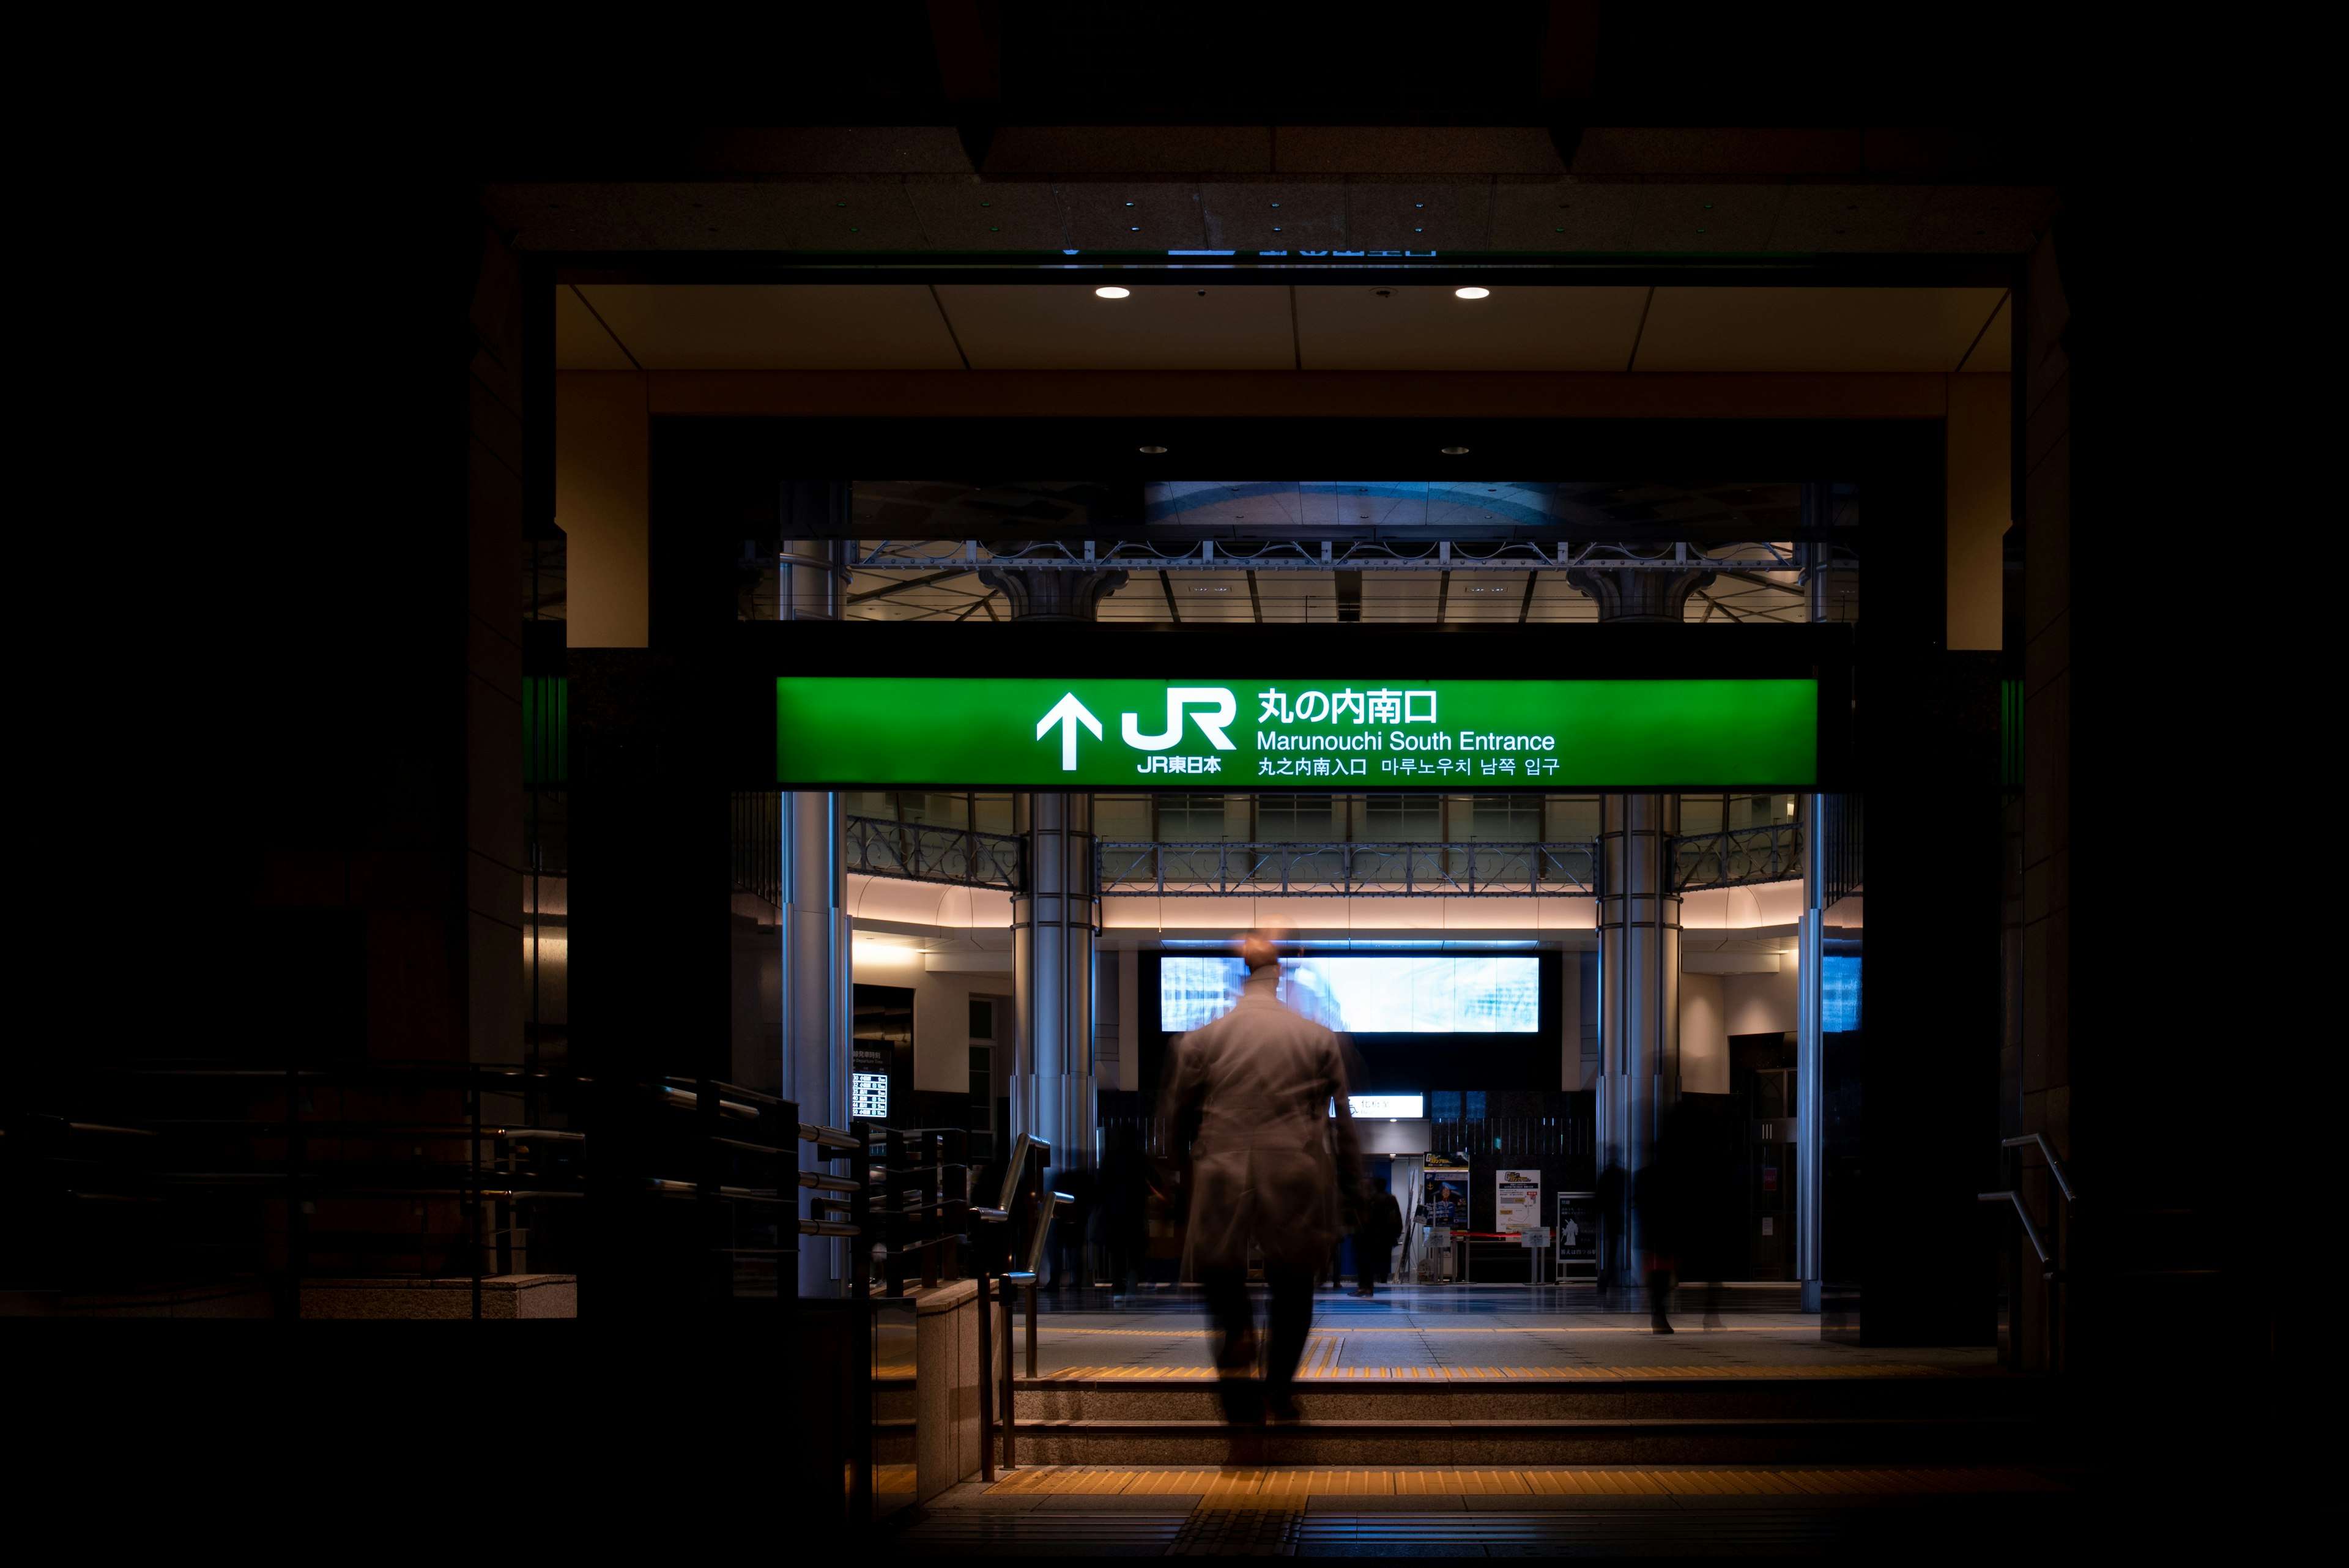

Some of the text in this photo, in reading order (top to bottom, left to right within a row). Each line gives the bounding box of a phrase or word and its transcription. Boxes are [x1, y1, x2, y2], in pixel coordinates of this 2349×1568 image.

[1258, 688, 1437, 724] 丸の内南口
[1122, 688, 1236, 751] JR
[1257, 731, 1555, 751] Marunouchi South Entrance
[1137, 756, 1222, 774] JR東日本
[1258, 757, 1366, 776] 丸之内南入口
[1382, 757, 1560, 776] 마루노우치 남쪽 입구
